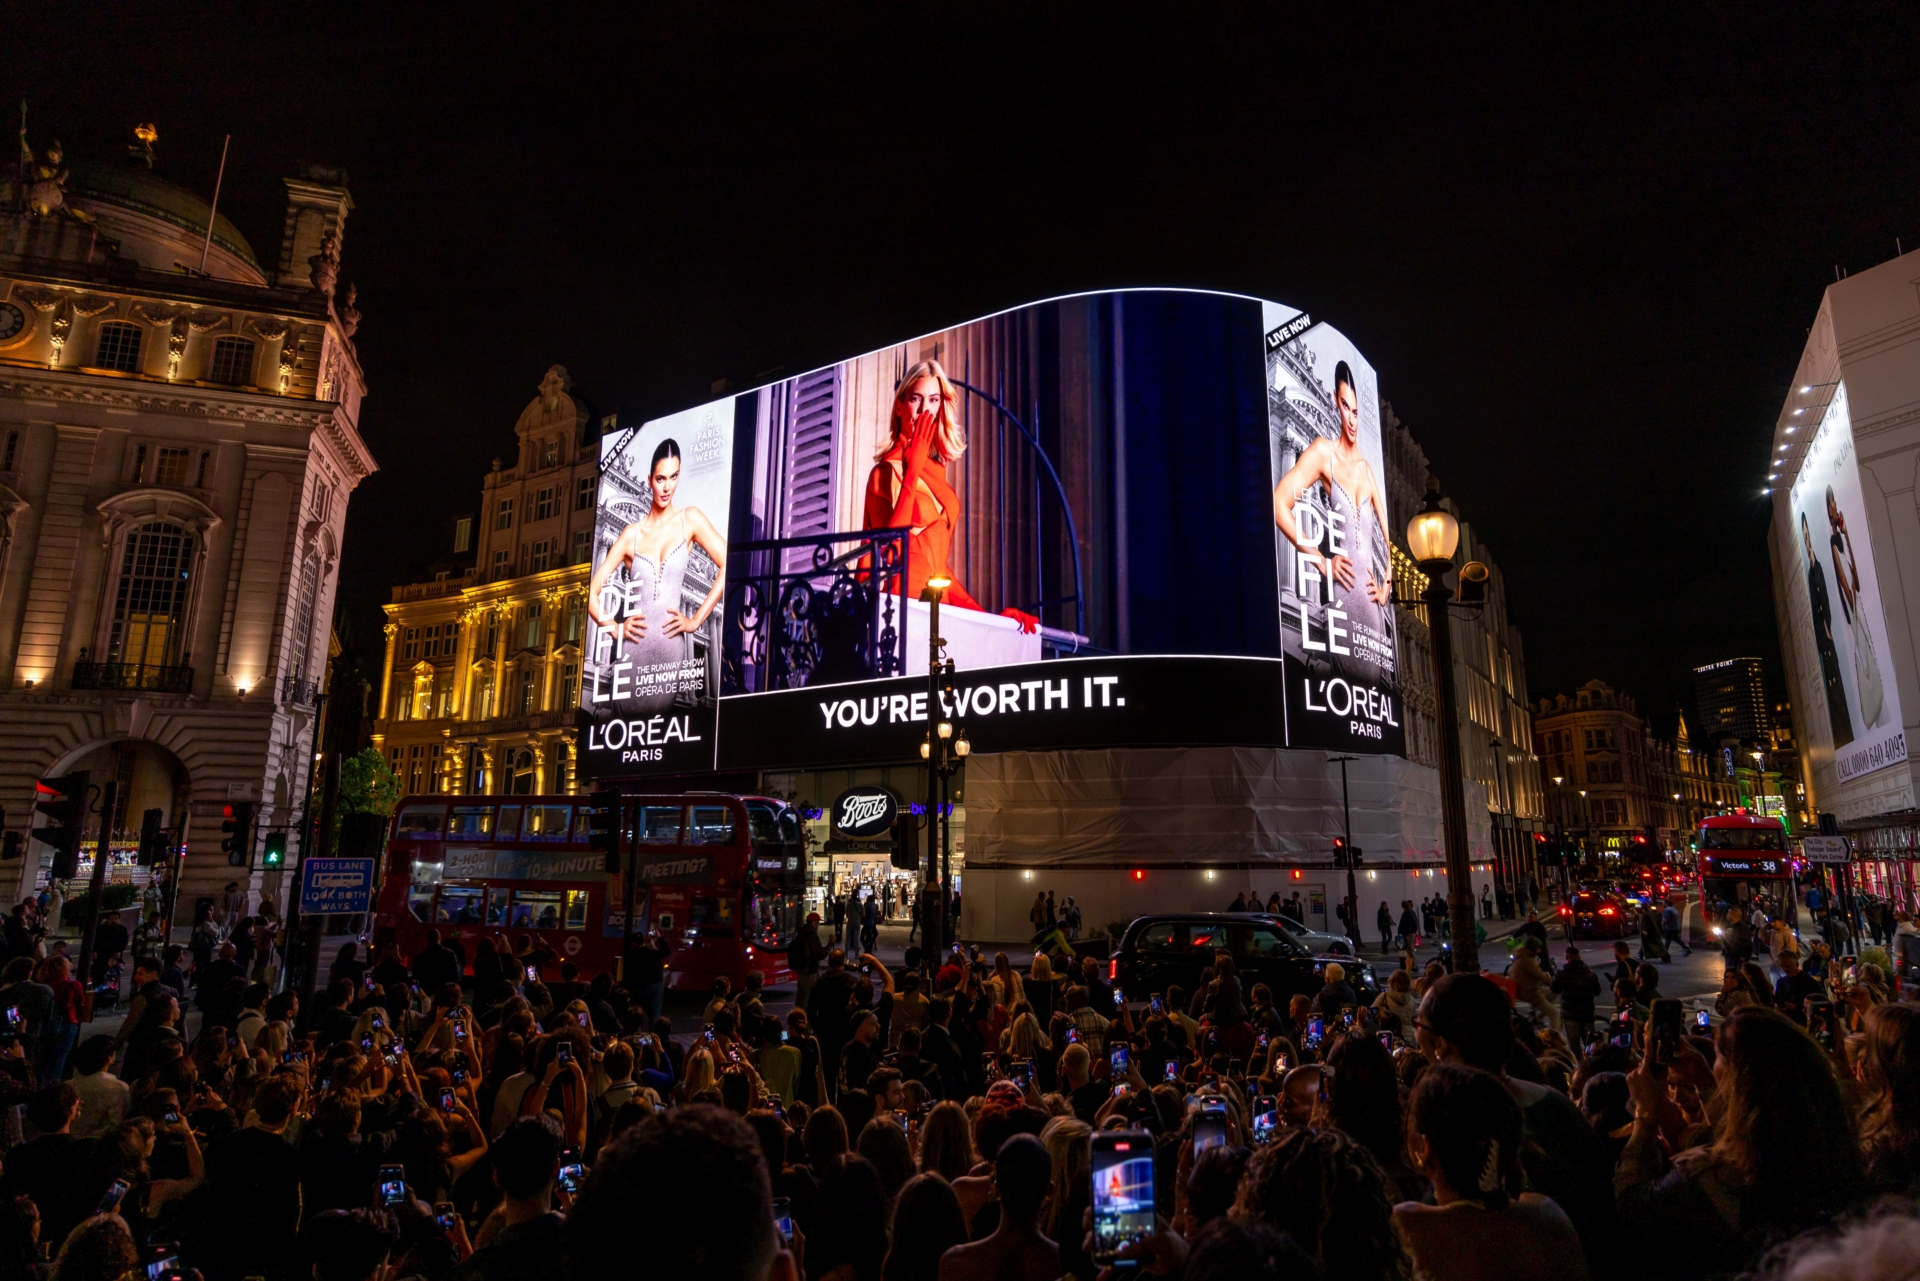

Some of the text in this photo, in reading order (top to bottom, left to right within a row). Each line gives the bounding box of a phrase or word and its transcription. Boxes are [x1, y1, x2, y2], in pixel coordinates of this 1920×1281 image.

[1267, 314, 1311, 347] LIVE NOW
[697, 427, 720, 442] PARIS
[600, 427, 634, 472] LIVE NOW
[689, 436, 726, 455] FASHION
[695, 448, 719, 463] WEEK
[1833, 437, 1852, 475] PRADA
[1352, 620, 1363, 633] THE
[1352, 632, 1367, 647] LIVE
[637, 657, 705, 674] THE RUNWAY SHOW
[635, 667, 705, 686] LIVE NOW FROM
[635, 679, 704, 697] OPÉRA DE PARIS
[819, 676, 1126, 730] YOU'RE WORTH IT.
[1304, 678, 1399, 727] L'ORÉAL
[589, 714, 701, 750] L'ORÉAL
[1837, 757, 1852, 779] CALL
[1851, 749, 1869, 774] 0800
[1869, 743, 1884, 768] 640
[837, 793, 887, 829] Boots
[313, 861, 366, 870] BUS LANE
[525, 855, 708, 879] 10-MINUTE MEETING?
[1720, 860, 1776, 871] Victoria 38
[305, 890, 367, 901] LOOK BOTH
[321, 902, 351, 911] WAYS
